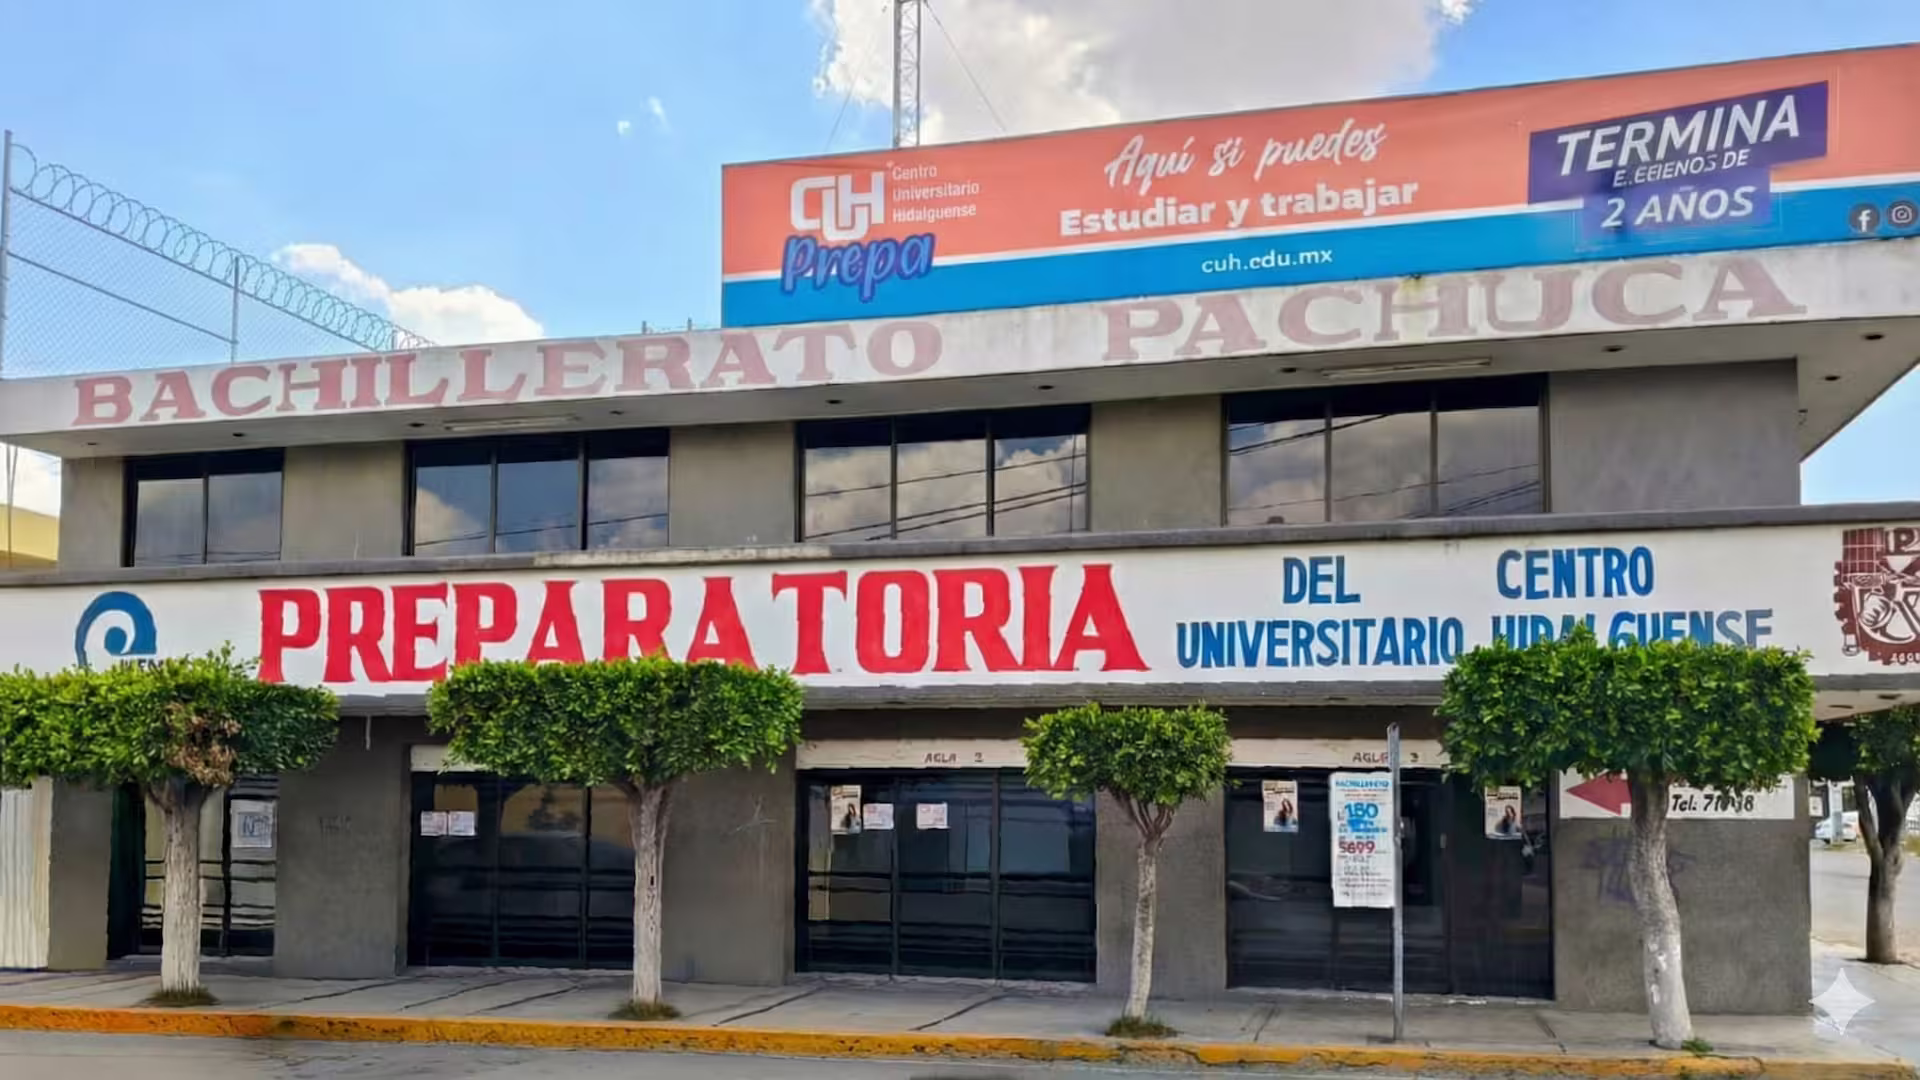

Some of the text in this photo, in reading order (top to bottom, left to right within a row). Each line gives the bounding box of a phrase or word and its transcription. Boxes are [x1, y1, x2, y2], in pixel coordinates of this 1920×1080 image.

[1103, 118, 1389, 196] Aquí si puedes
[1556, 94, 1800, 177] TERMINA
[1721, 148, 1751, 170] DE
[892, 164, 938, 181] Centro
[892, 181, 980, 201] Universitario
[791, 171, 885, 241] CUH
[892, 203, 977, 224] Hidalguense
[1060, 179, 1419, 237] Estudiar y trabajar
[1600, 185, 1757, 229] 2 AÑOS
[782, 234, 935, 303] Prepa
[71, 257, 1808, 428] BACHILLERATO PACHUCA
[1282, 546, 1656, 605] DEL CENTRO
[258, 563, 1152, 684] PREPARATORIA
[1176, 616, 1465, 668] UNIVERSITARIO
